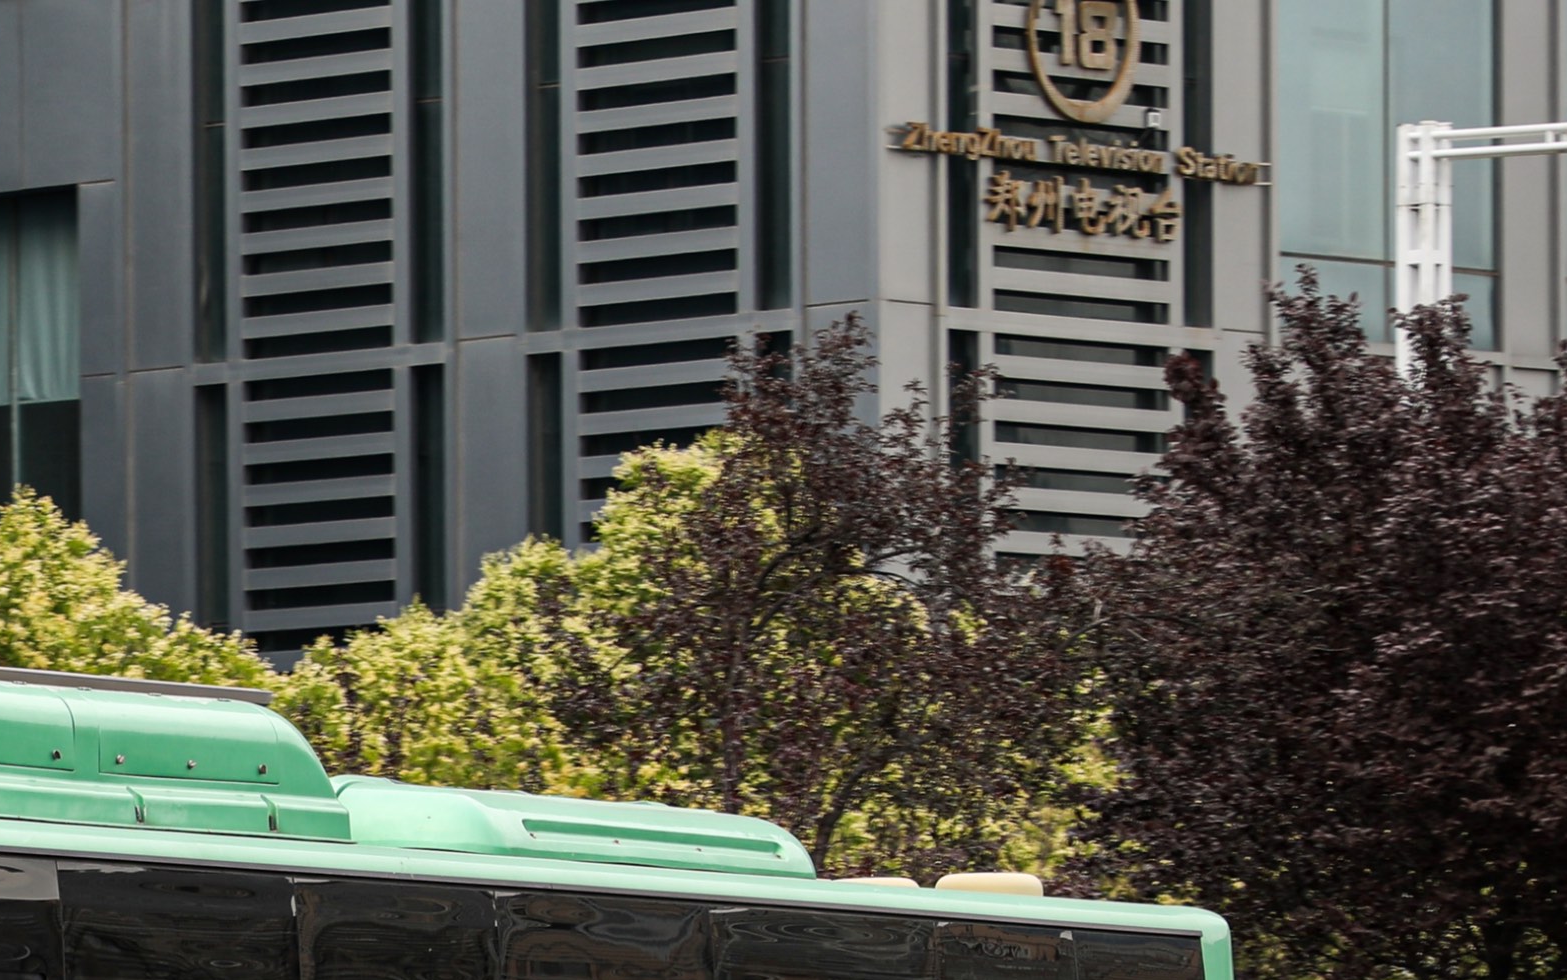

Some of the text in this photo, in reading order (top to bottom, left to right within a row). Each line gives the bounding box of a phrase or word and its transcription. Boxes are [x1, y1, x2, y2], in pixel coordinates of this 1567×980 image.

[902, 121, 1260, 186] ZhengZhou Television Station
[985, 169, 1182, 243] 郑州电视台
